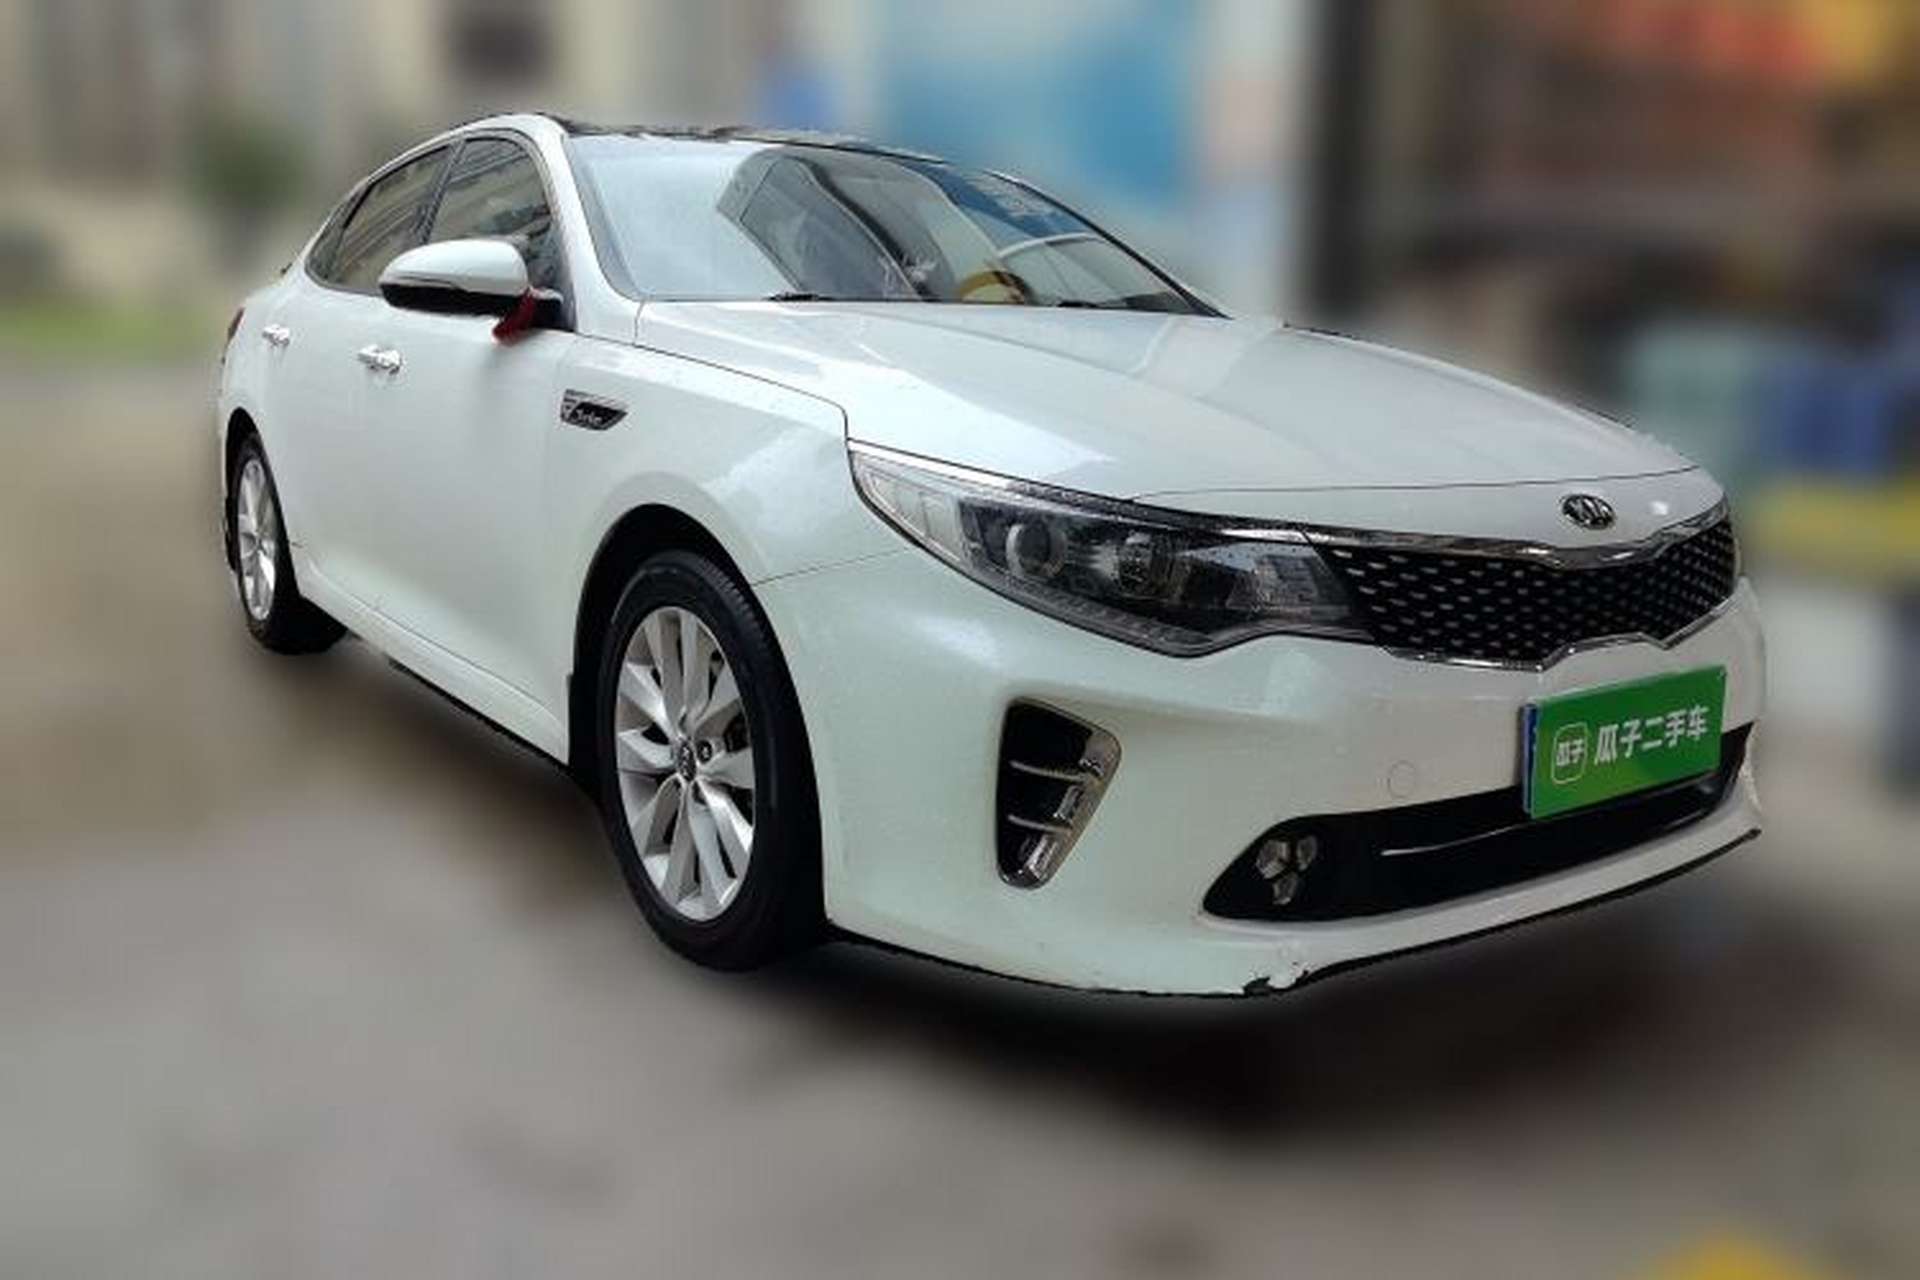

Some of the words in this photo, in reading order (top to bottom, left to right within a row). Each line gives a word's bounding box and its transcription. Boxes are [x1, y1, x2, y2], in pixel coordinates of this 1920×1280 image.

[1594, 704, 1709, 765] 瓜子二手车
